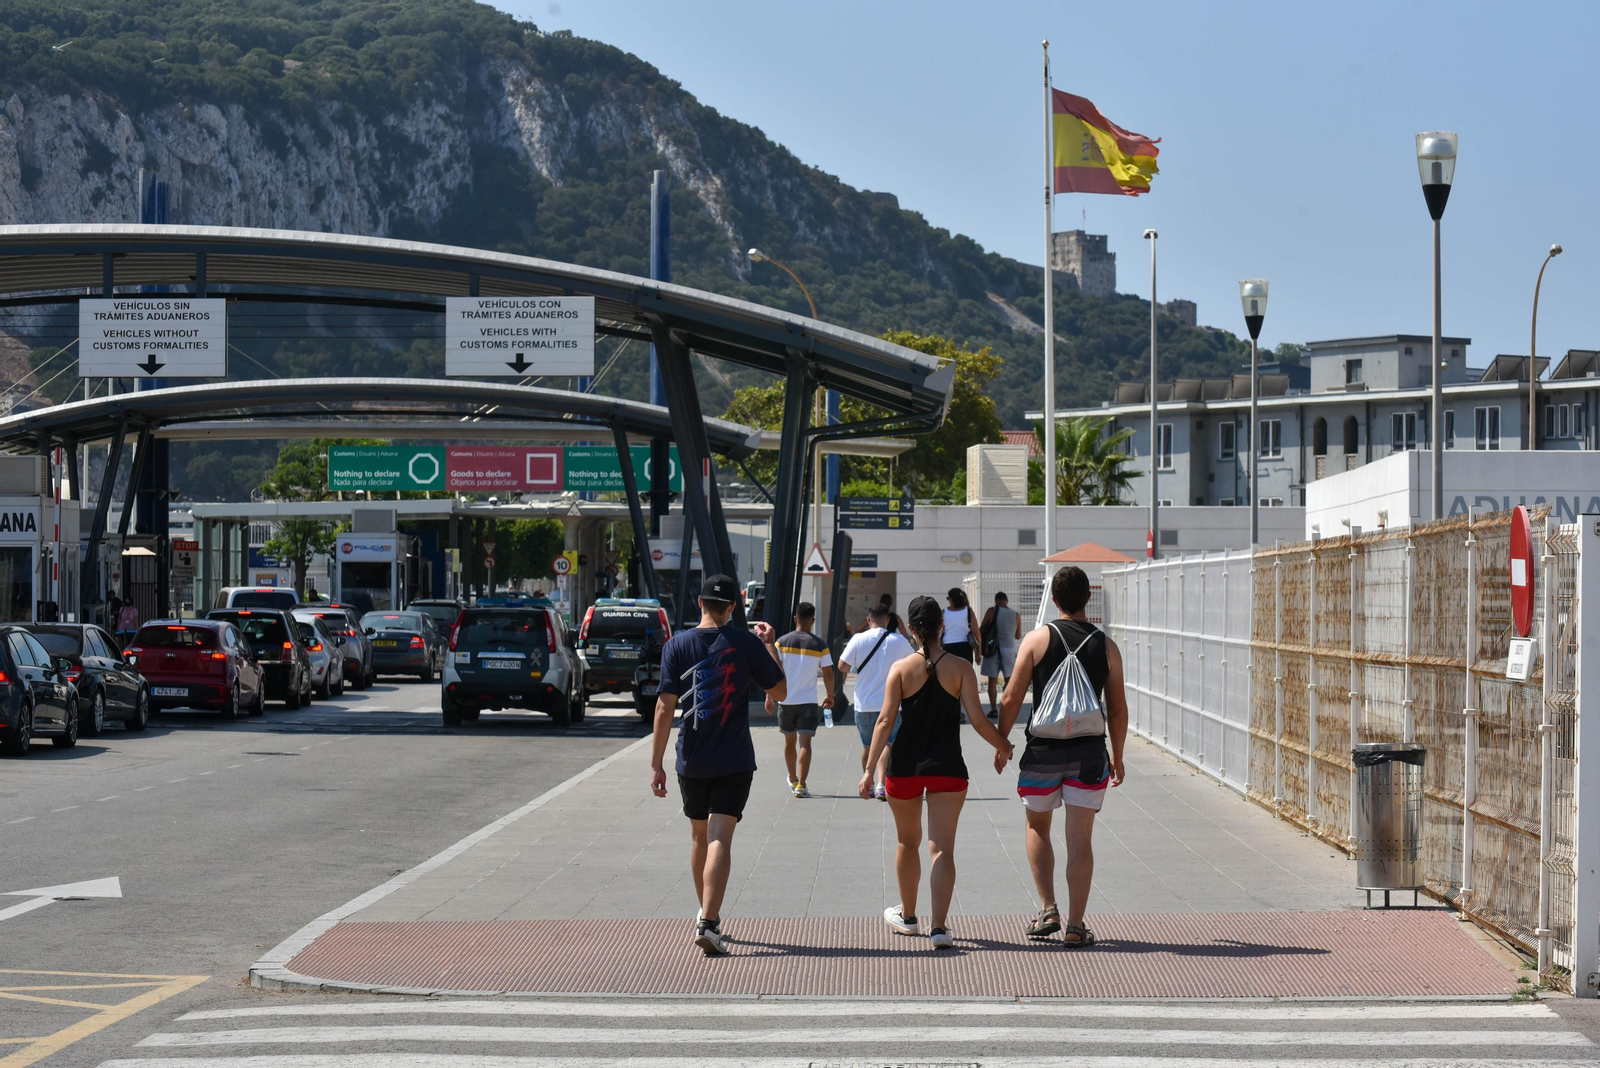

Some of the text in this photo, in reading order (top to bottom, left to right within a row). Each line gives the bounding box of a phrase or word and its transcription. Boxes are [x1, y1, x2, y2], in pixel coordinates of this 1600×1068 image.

[114, 300, 190, 310] VEHÍCULOS SIN
[478, 299, 561, 308] VEHÍCULOS CON
[94, 311, 210, 320] TRÁMITES ADUANEROS
[461, 310, 512, 319] TRÁMITES
[103, 330, 199, 338] VEHICLES WITHOUT
[480, 328, 557, 336] VEHICLES WITH
[93, 342, 209, 350] CUSTOMS FORMALITIES
[460, 340, 578, 349] CUSTOMS FORMALITIES
[334, 470, 363, 479] Nothing
[569, 471, 598, 479] Nothing
[1448, 496, 1600, 523] ADAN
[0, 513, 36, 532] ANA
[556, 561, 568, 570] 10
